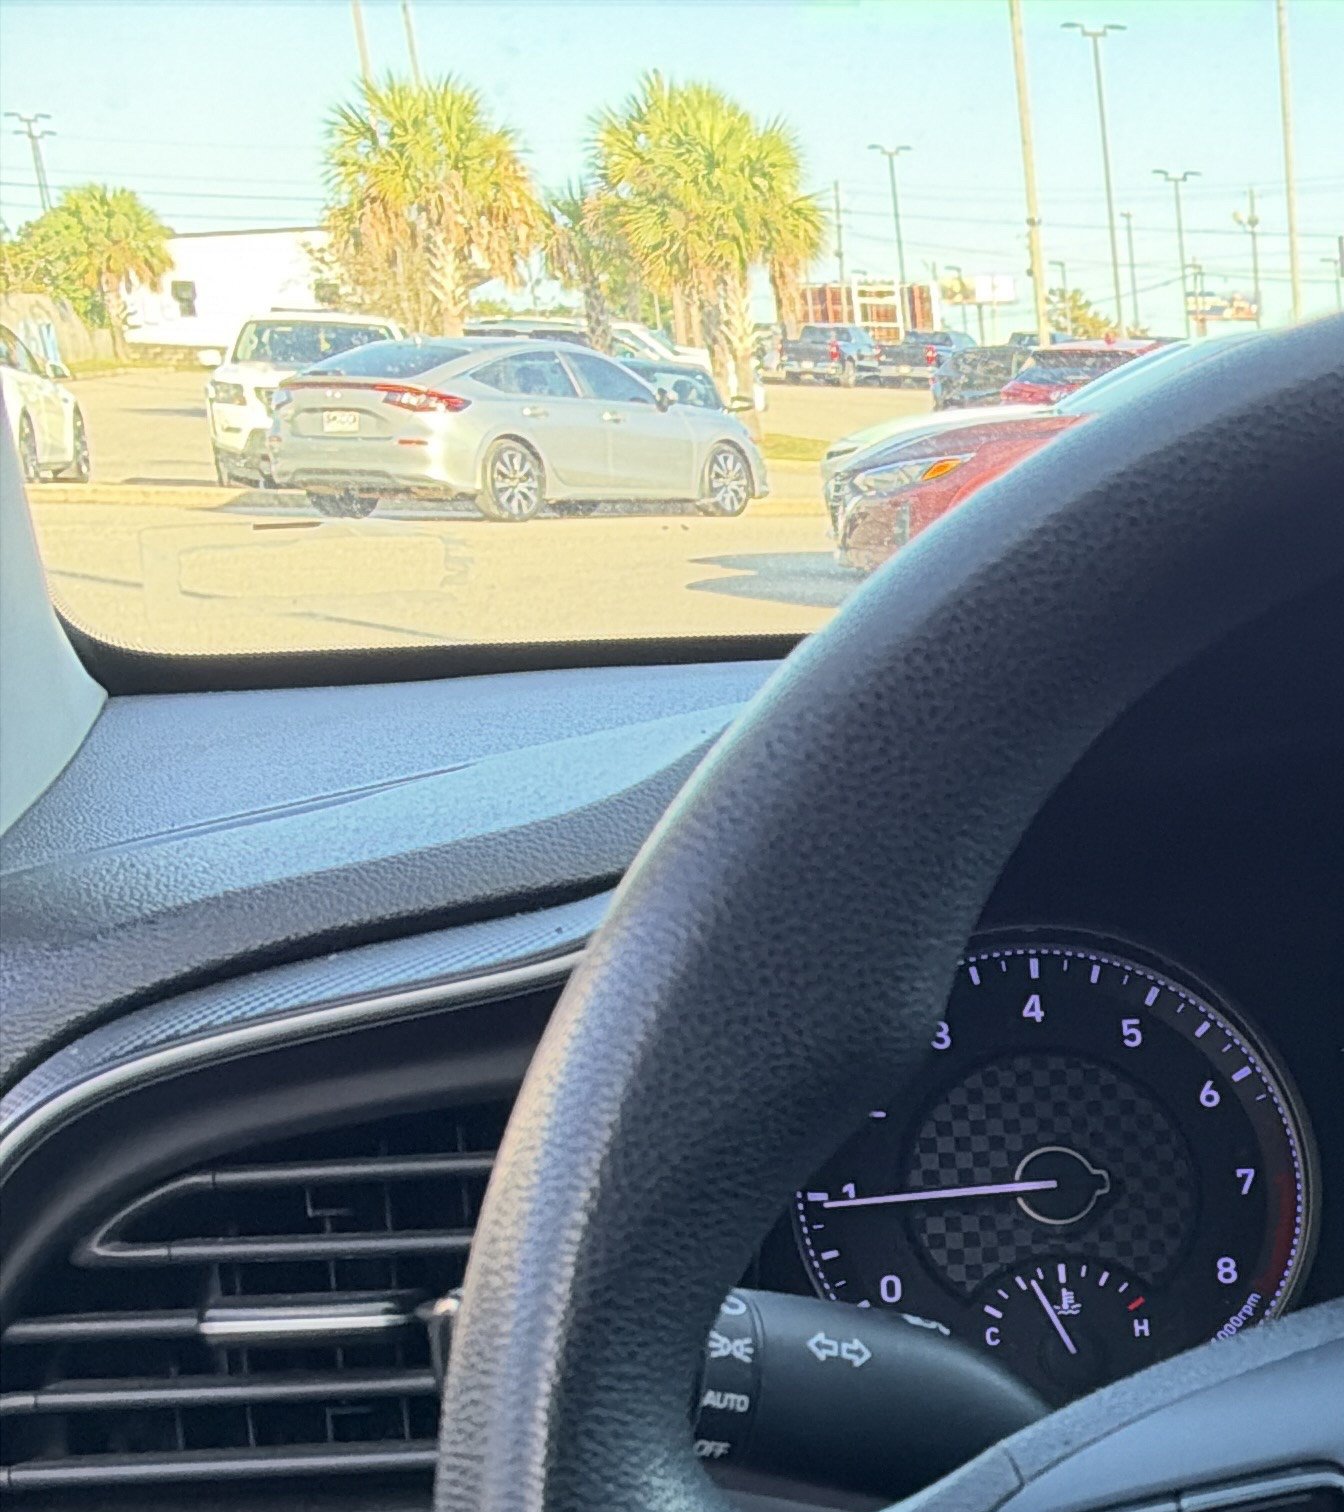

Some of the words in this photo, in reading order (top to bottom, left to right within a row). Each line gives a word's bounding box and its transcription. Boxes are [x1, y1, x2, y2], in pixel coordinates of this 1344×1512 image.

[1022, 994, 1045, 1022] 4
[930, 1021, 952, 1050] 3
[1122, 1018, 1143, 1047] 5
[1200, 1080, 1220, 1108] 6
[1235, 1168, 1255, 1195] 7
[1217, 1256, 1238, 1284] 8
[880, 1274, 902, 1302] 0
[985, 1326, 1001, 1346] C
[1133, 1318, 1151, 1337] H
[700, 1389, 750, 1414] AUTO
[696, 1439, 731, 1459] OFF
